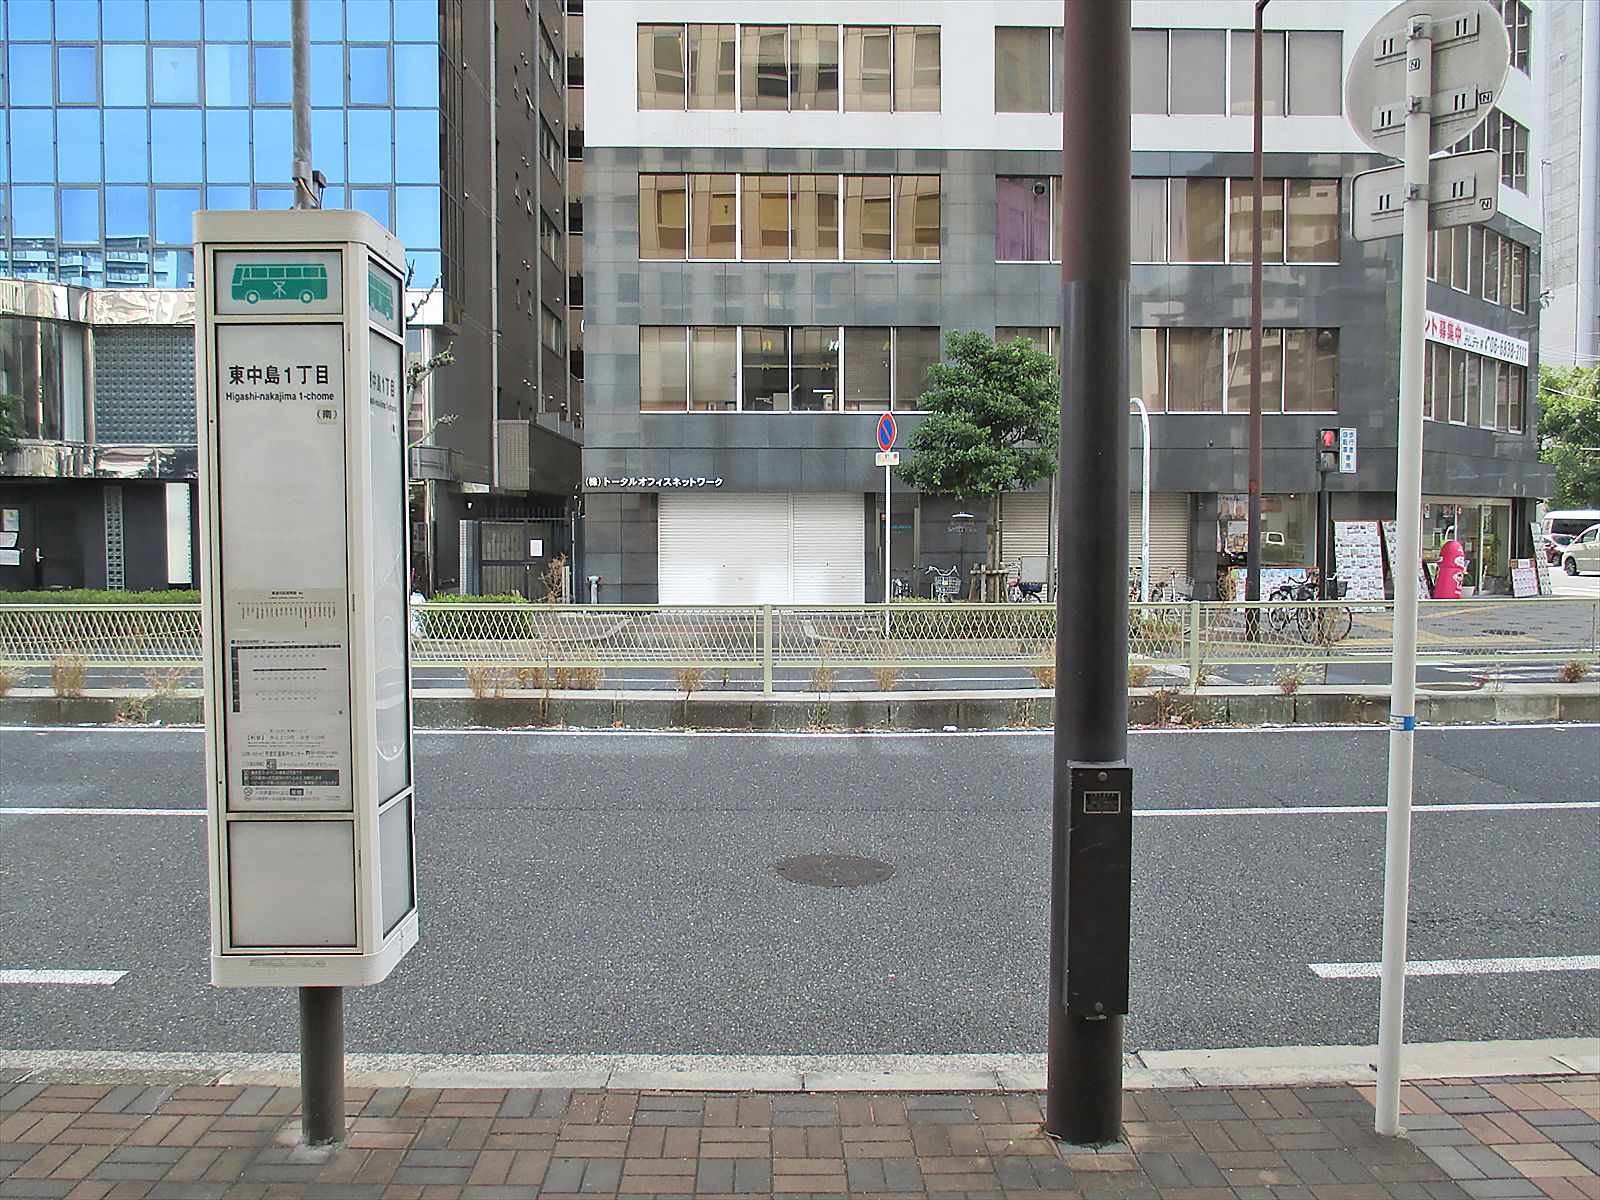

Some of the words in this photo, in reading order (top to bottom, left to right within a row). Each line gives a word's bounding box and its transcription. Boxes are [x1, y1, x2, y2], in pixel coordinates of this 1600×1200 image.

[228, 365, 329, 385] 東中島1丁目
[226, 392, 297, 402] Higashi-nakajima
[299, 392, 335, 401] 1-chome
